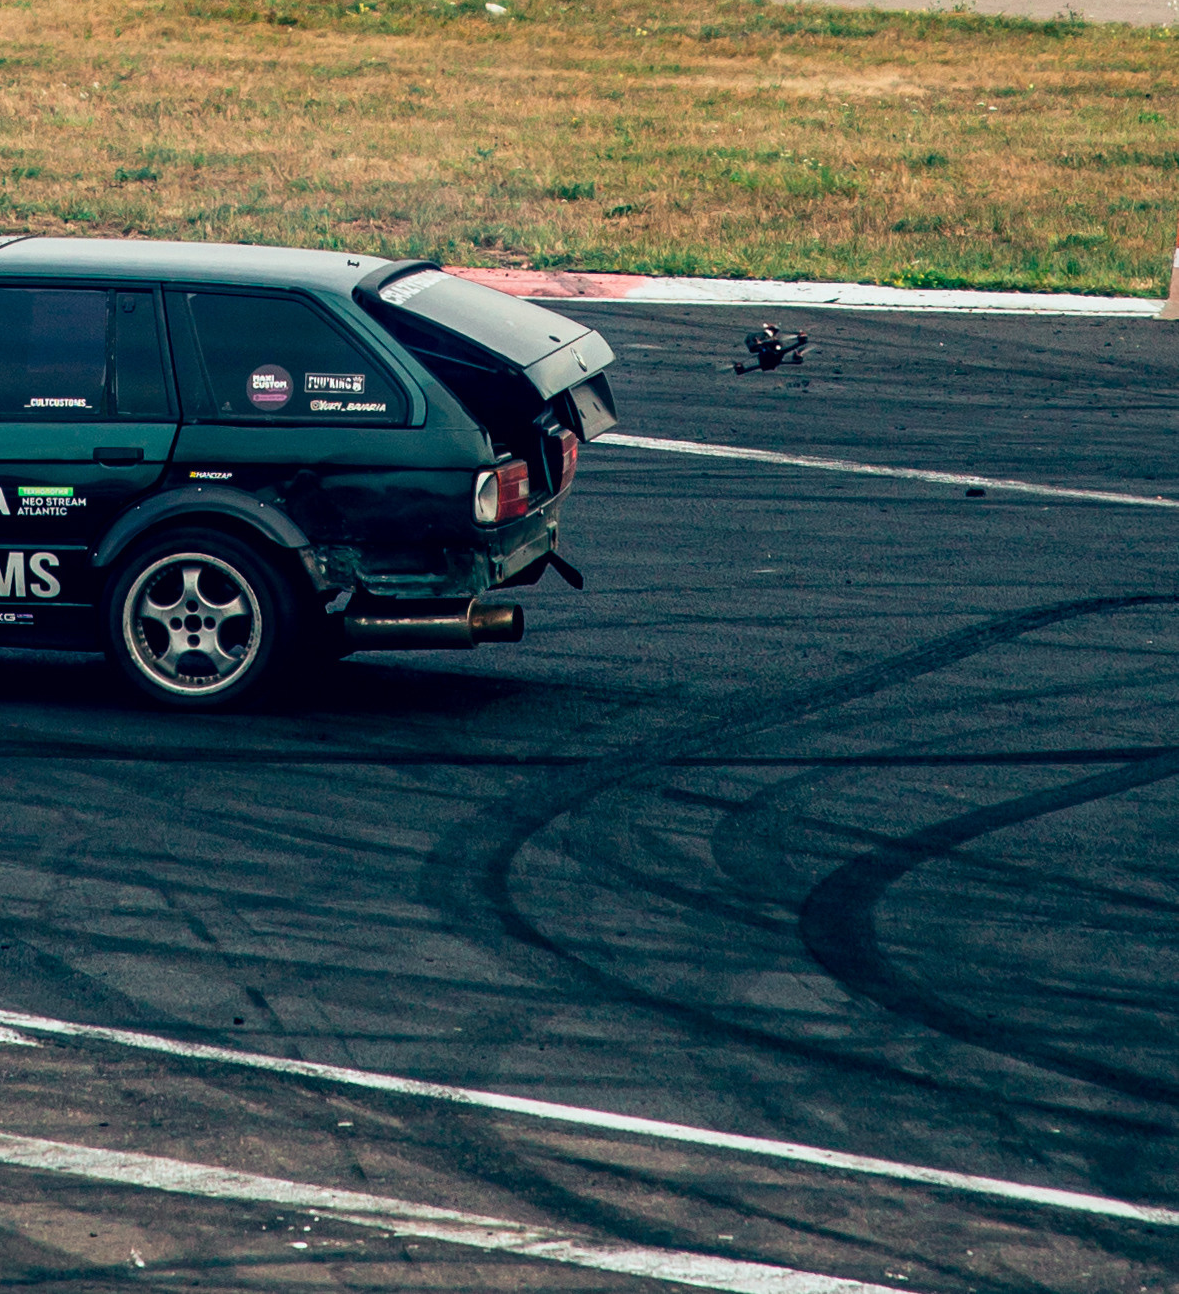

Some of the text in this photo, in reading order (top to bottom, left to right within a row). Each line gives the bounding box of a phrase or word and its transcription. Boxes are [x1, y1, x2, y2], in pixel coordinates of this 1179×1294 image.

[22, 497, 87, 507] NEO STREAM
[17, 506, 68, 516] ATLANTIC
